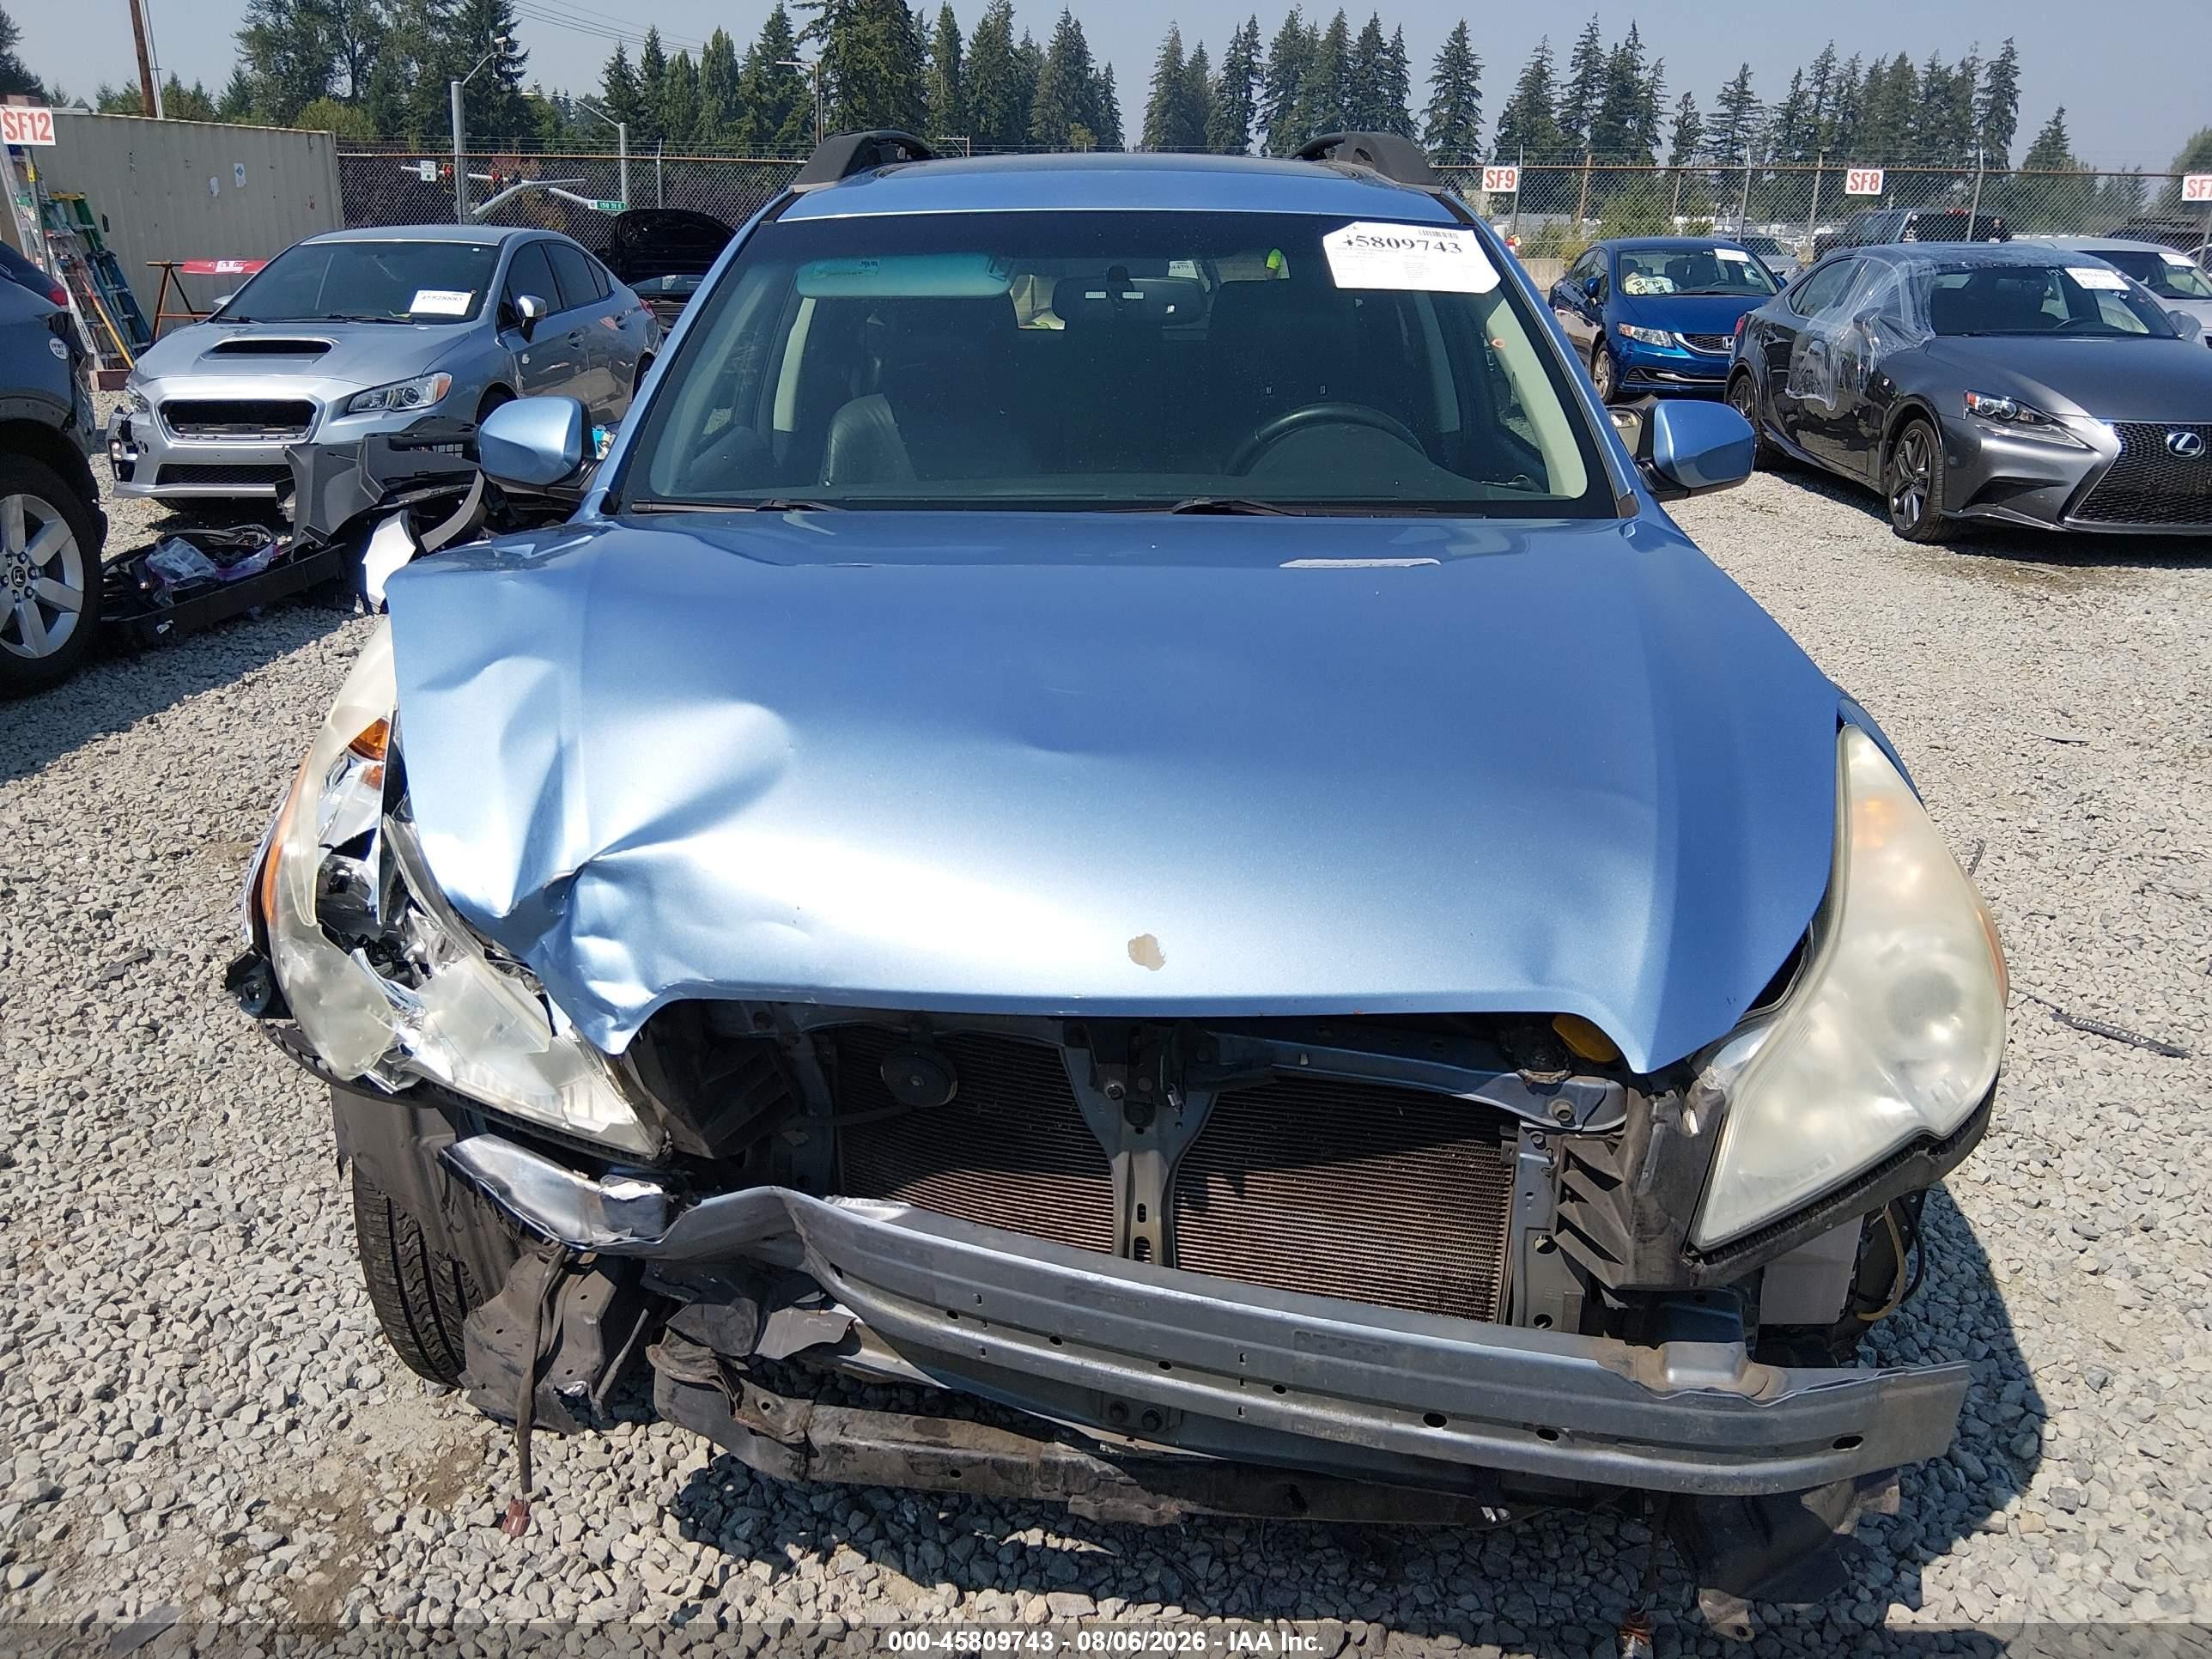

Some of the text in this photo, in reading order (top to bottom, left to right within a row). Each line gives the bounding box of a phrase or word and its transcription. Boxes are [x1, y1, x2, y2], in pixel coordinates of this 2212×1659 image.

[3, 112, 53, 141] SF12
[1486, 169, 1516, 189] SF9
[1849, 172, 1881, 191] SF8
[1342, 234, 1462, 254] 45809743
